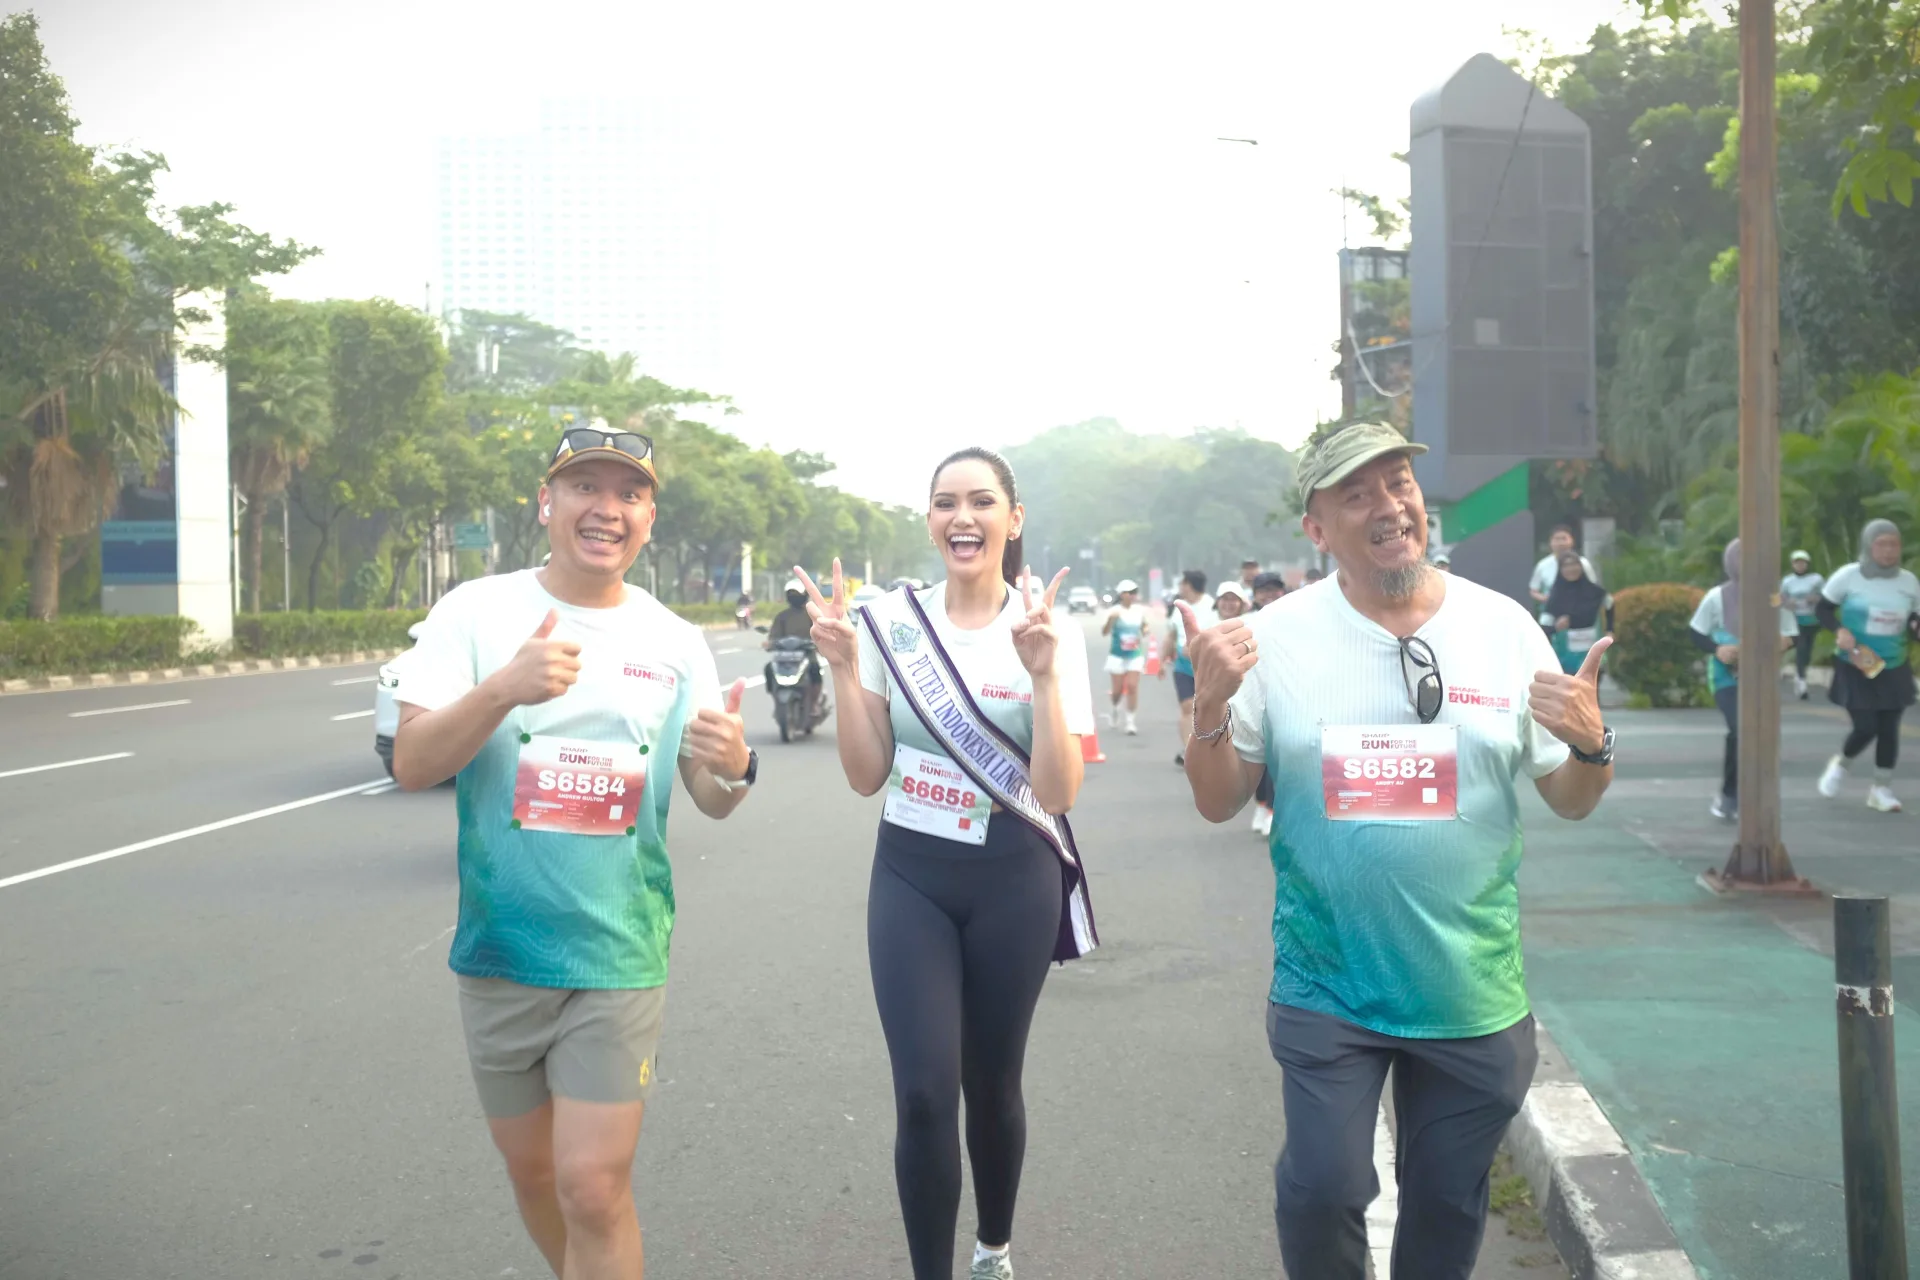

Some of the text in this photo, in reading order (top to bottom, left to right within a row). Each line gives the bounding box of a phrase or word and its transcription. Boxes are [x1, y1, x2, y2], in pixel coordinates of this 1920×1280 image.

[1448, 692, 1480, 705] RUN
[907, 653, 949, 707] PUTERI
[933, 698, 998, 770] INDONESIA
[988, 756, 1055, 825] LINGKUN
[1361, 739, 1390, 750] RUN
[559, 753, 587, 765] RUN
[1343, 758, 1436, 779] S6582
[537, 769, 626, 797] S6584
[901, 775, 977, 809] S6658
